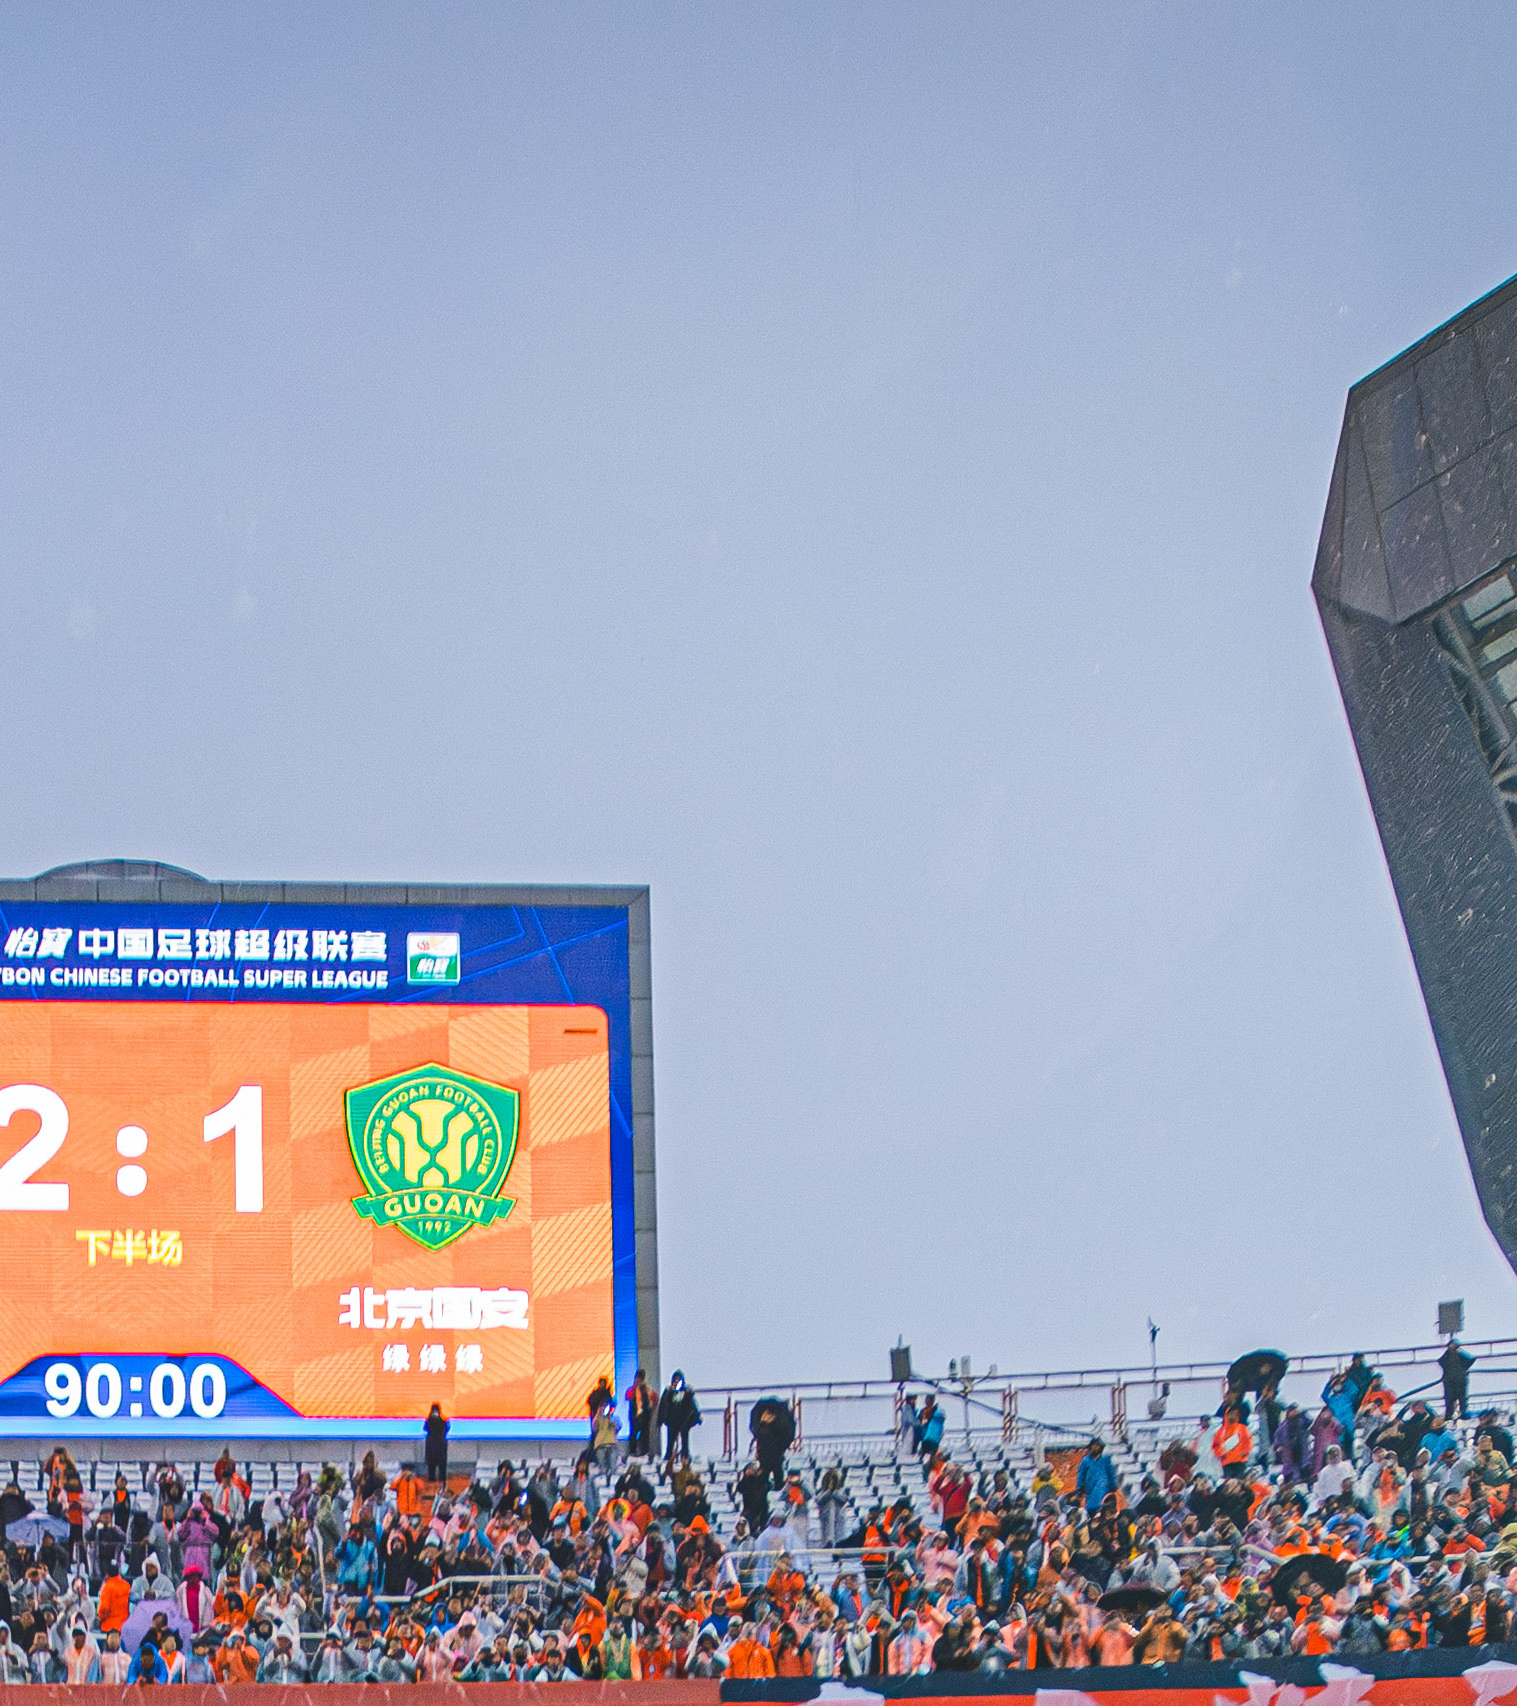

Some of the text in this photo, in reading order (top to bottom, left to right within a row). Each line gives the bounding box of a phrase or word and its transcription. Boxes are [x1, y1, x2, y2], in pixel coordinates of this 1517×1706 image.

[78, 927, 387, 960] 中国足球超级联赛
[50, 967, 133, 987] CHINESE
[137, 968, 238, 988] FOOTBALL
[243, 969, 306, 988] SUPER
[311, 969, 387, 989] LEAGUE
[435, 1085, 492, 1136] FOOTBALL
[202, 1085, 264, 1211] 1
[384, 1196, 484, 1218] GUOAN
[417, 1220, 452, 1235] 1992
[76, 1228, 183, 1267] 下半场
[45, 1363, 227, 1420] 90:00
